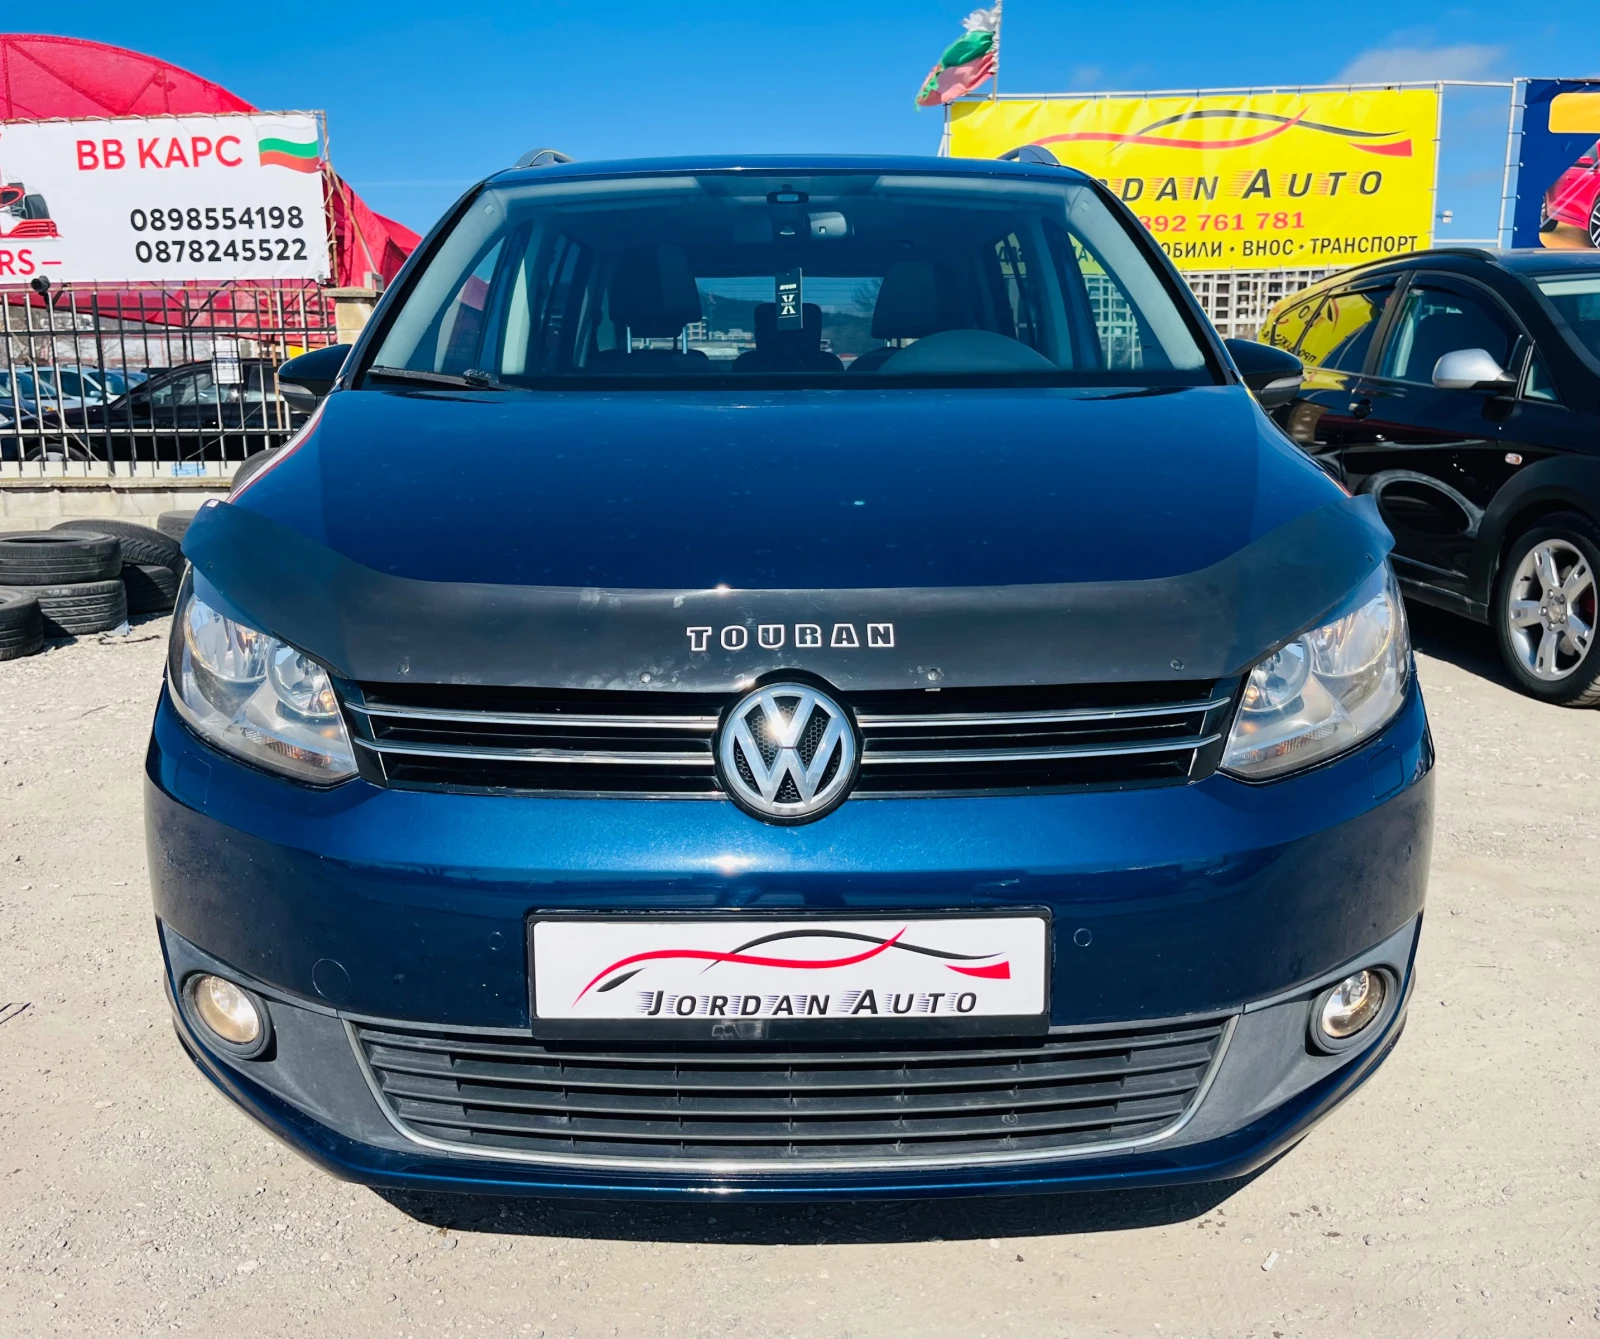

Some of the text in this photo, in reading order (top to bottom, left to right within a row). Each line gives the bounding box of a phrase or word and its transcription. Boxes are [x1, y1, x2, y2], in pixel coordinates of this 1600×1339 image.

[137, 135, 244, 169] КАРС
[1241, 168, 1383, 200] AUTO
[130, 205, 304, 232] 0898554198
[1197, 213, 1245, 232] 761
[1256, 211, 1305, 231] 781
[135, 237, 308, 264] 0878245522
[1243, 239, 1294, 257] ВНОС
[1310, 236, 1418, 255] ТРАНСПОРТ
[686, 622, 895, 652] TOURAN
[646, 989, 977, 1017] JORDAN AUTO
